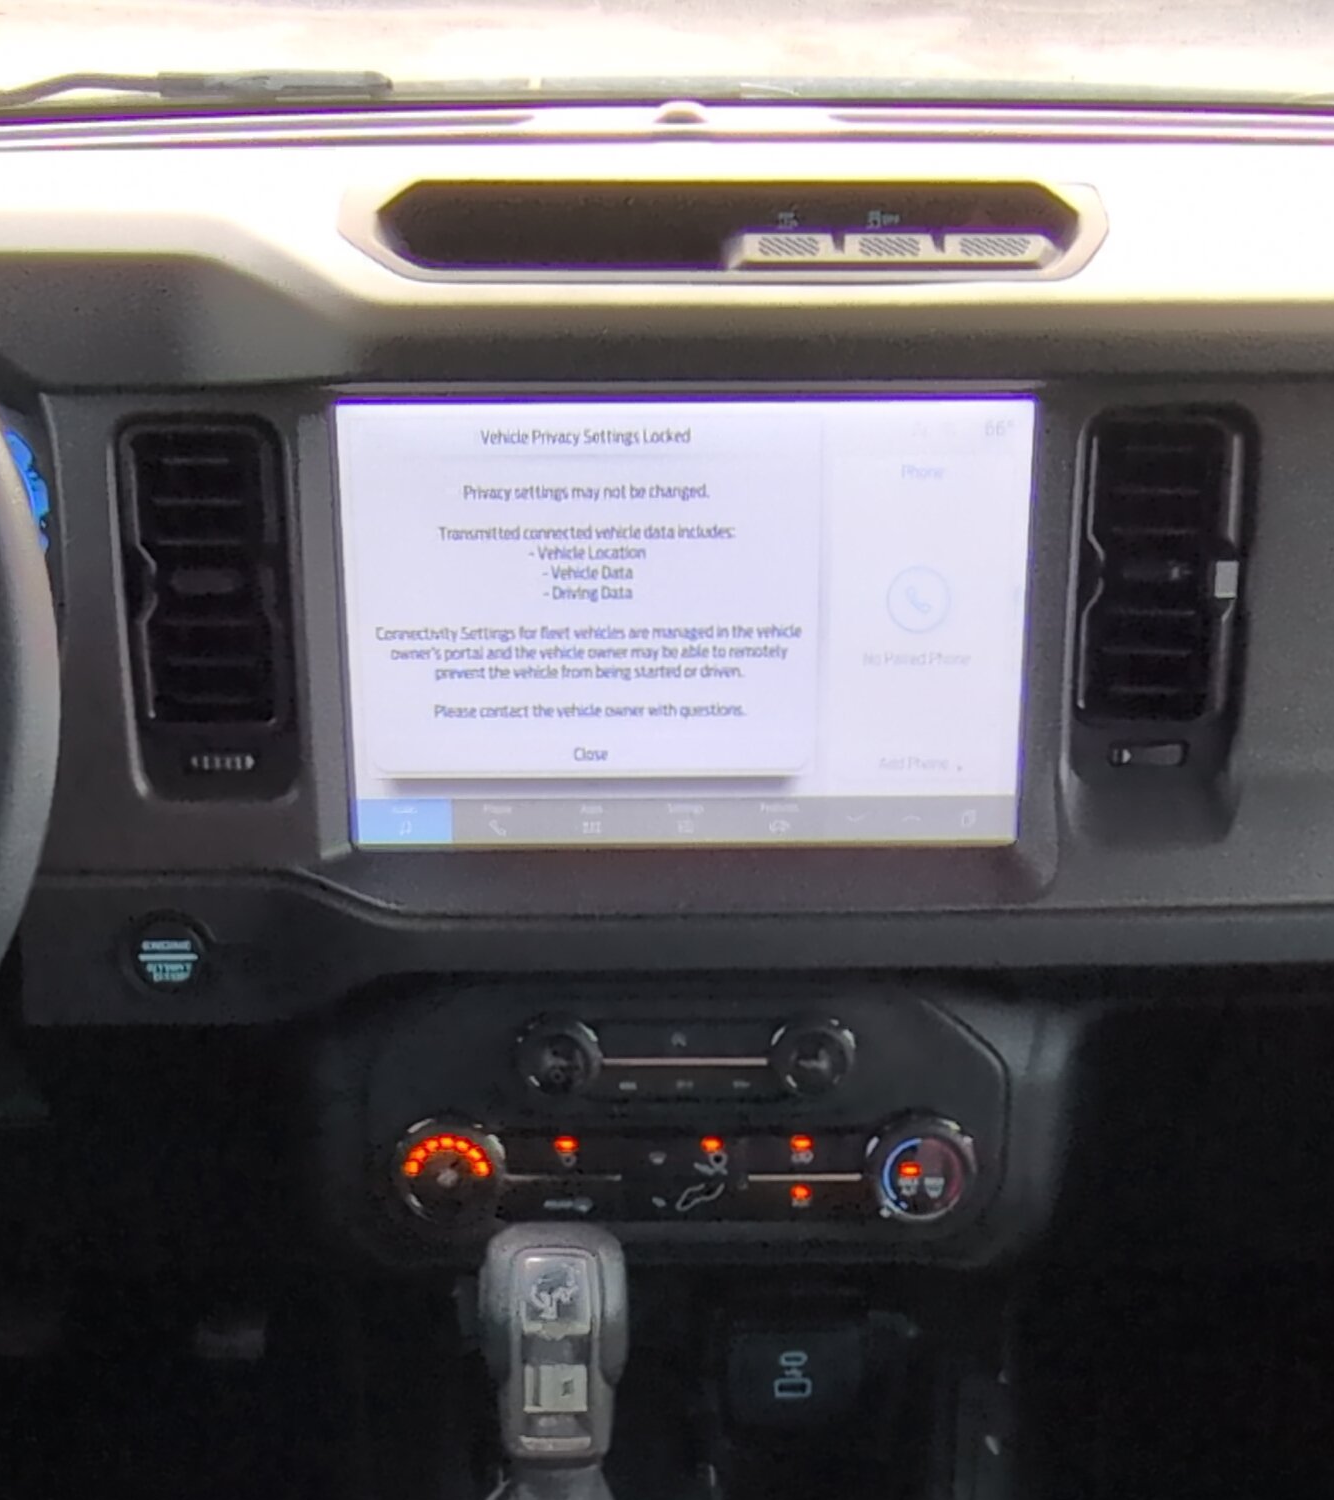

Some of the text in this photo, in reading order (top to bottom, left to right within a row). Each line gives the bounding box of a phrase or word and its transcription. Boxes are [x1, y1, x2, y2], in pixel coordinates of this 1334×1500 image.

[480, 427, 691, 448] Vehicle Privacy Settings Locked
[462, 483, 711, 503] Privacy settings may not be changed.
[437, 523, 736, 542] Transmitted connected vehicle data includes:
[537, 545, 586, 561] Vehicle
[588, 545, 647, 561] Location
[550, 565, 599, 581] Vehicle
[601, 564, 634, 581] Data
[551, 585, 599, 604] Driving
[600, 584, 634, 601] Data
[375, 623, 803, 644] Connectivity Settings for fleet vehicles are managed in the vehicle
[389, 643, 788, 663] owner's portal and the vehicle owner may be able to remotely
[434, 663, 746, 682] prevent the vehicle from being started or driven.
[433, 702, 748, 720] Please contact the vehicle owner with questions.
[573, 746, 609, 762] Close
